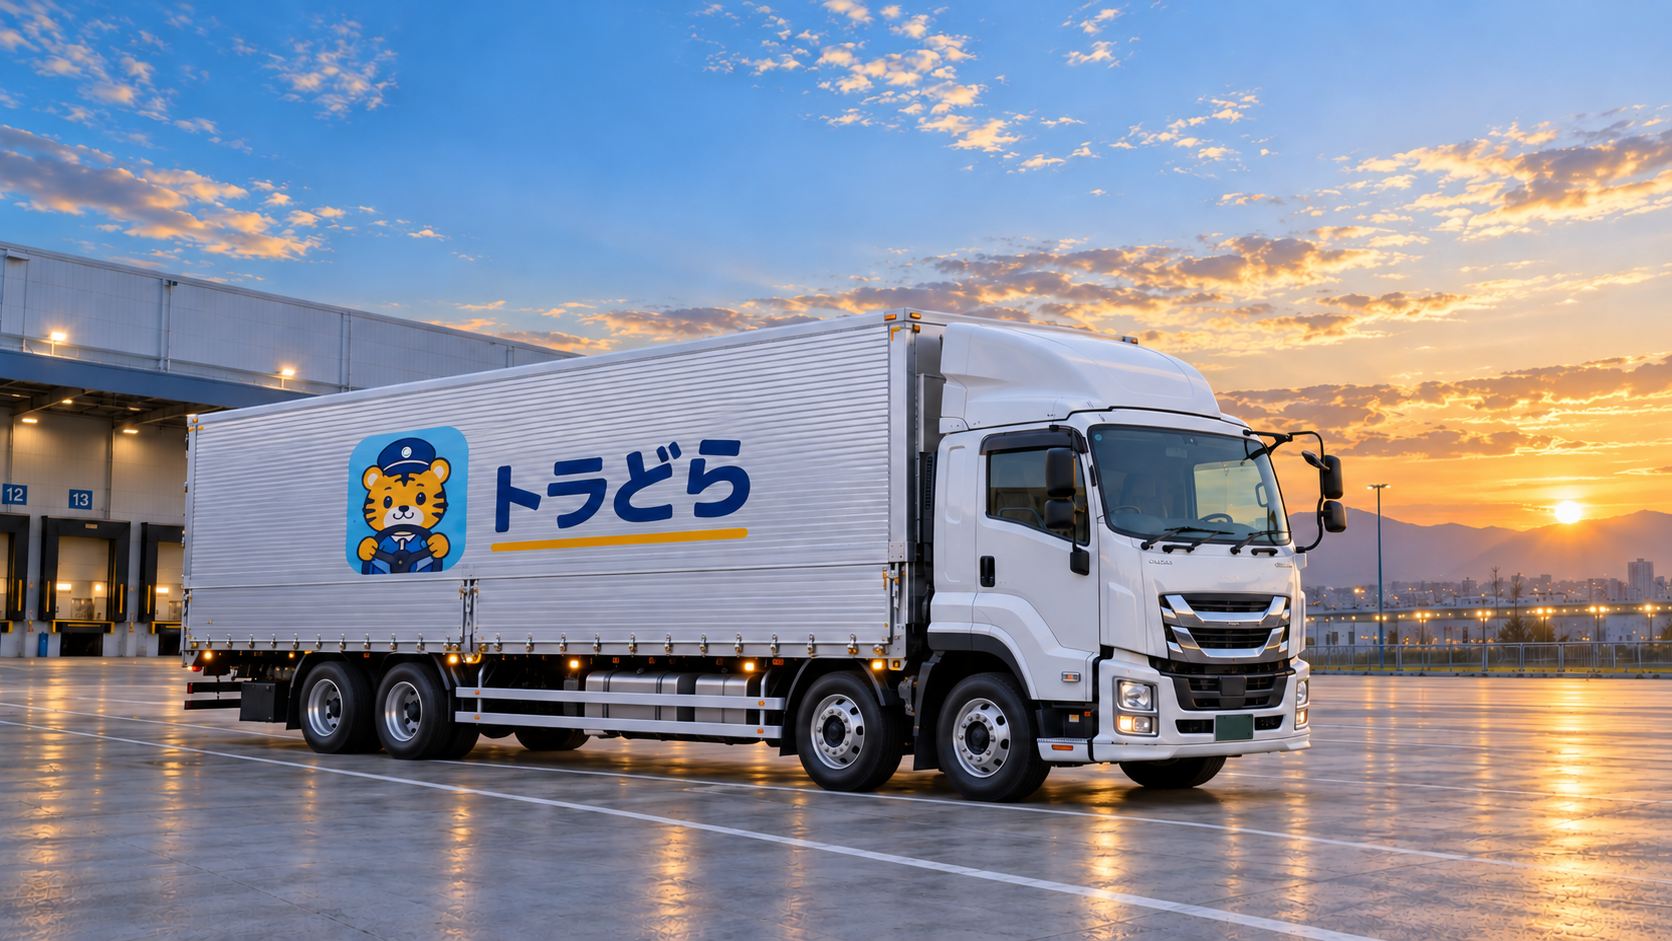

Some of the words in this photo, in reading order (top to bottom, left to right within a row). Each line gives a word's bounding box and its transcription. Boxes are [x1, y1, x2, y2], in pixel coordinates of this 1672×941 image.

[495, 439, 751, 533] トラどら
[6, 487, 23, 502] 12
[72, 493, 89, 506] 13
